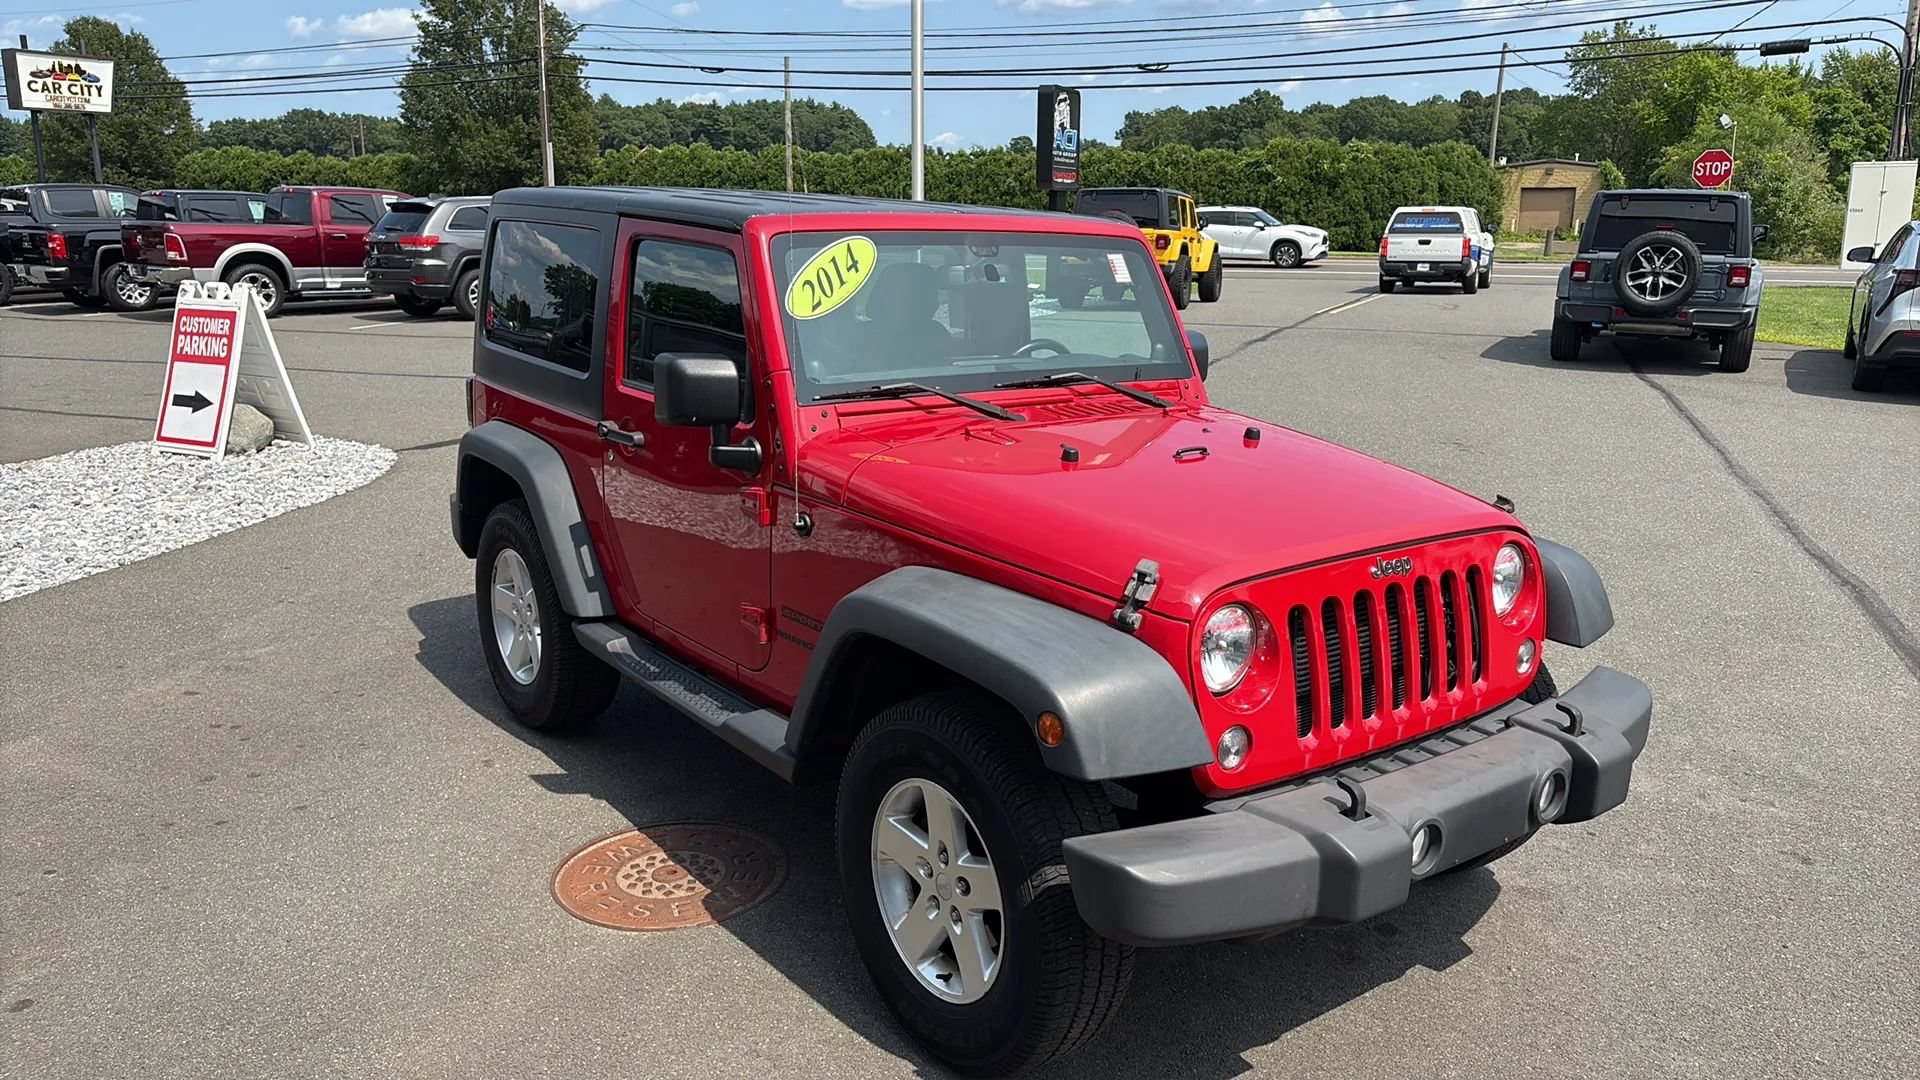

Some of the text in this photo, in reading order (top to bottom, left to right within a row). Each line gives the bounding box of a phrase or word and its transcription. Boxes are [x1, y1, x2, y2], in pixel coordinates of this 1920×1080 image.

[27, 80, 103, 97] CAR CITY
[1695, 161, 1730, 176] STOP
[802, 242, 859, 313] 2014
[179, 316, 231, 335] CUSTOMER
[176, 334, 228, 358] PARKING
[1370, 556, 1412, 579] Jeep
